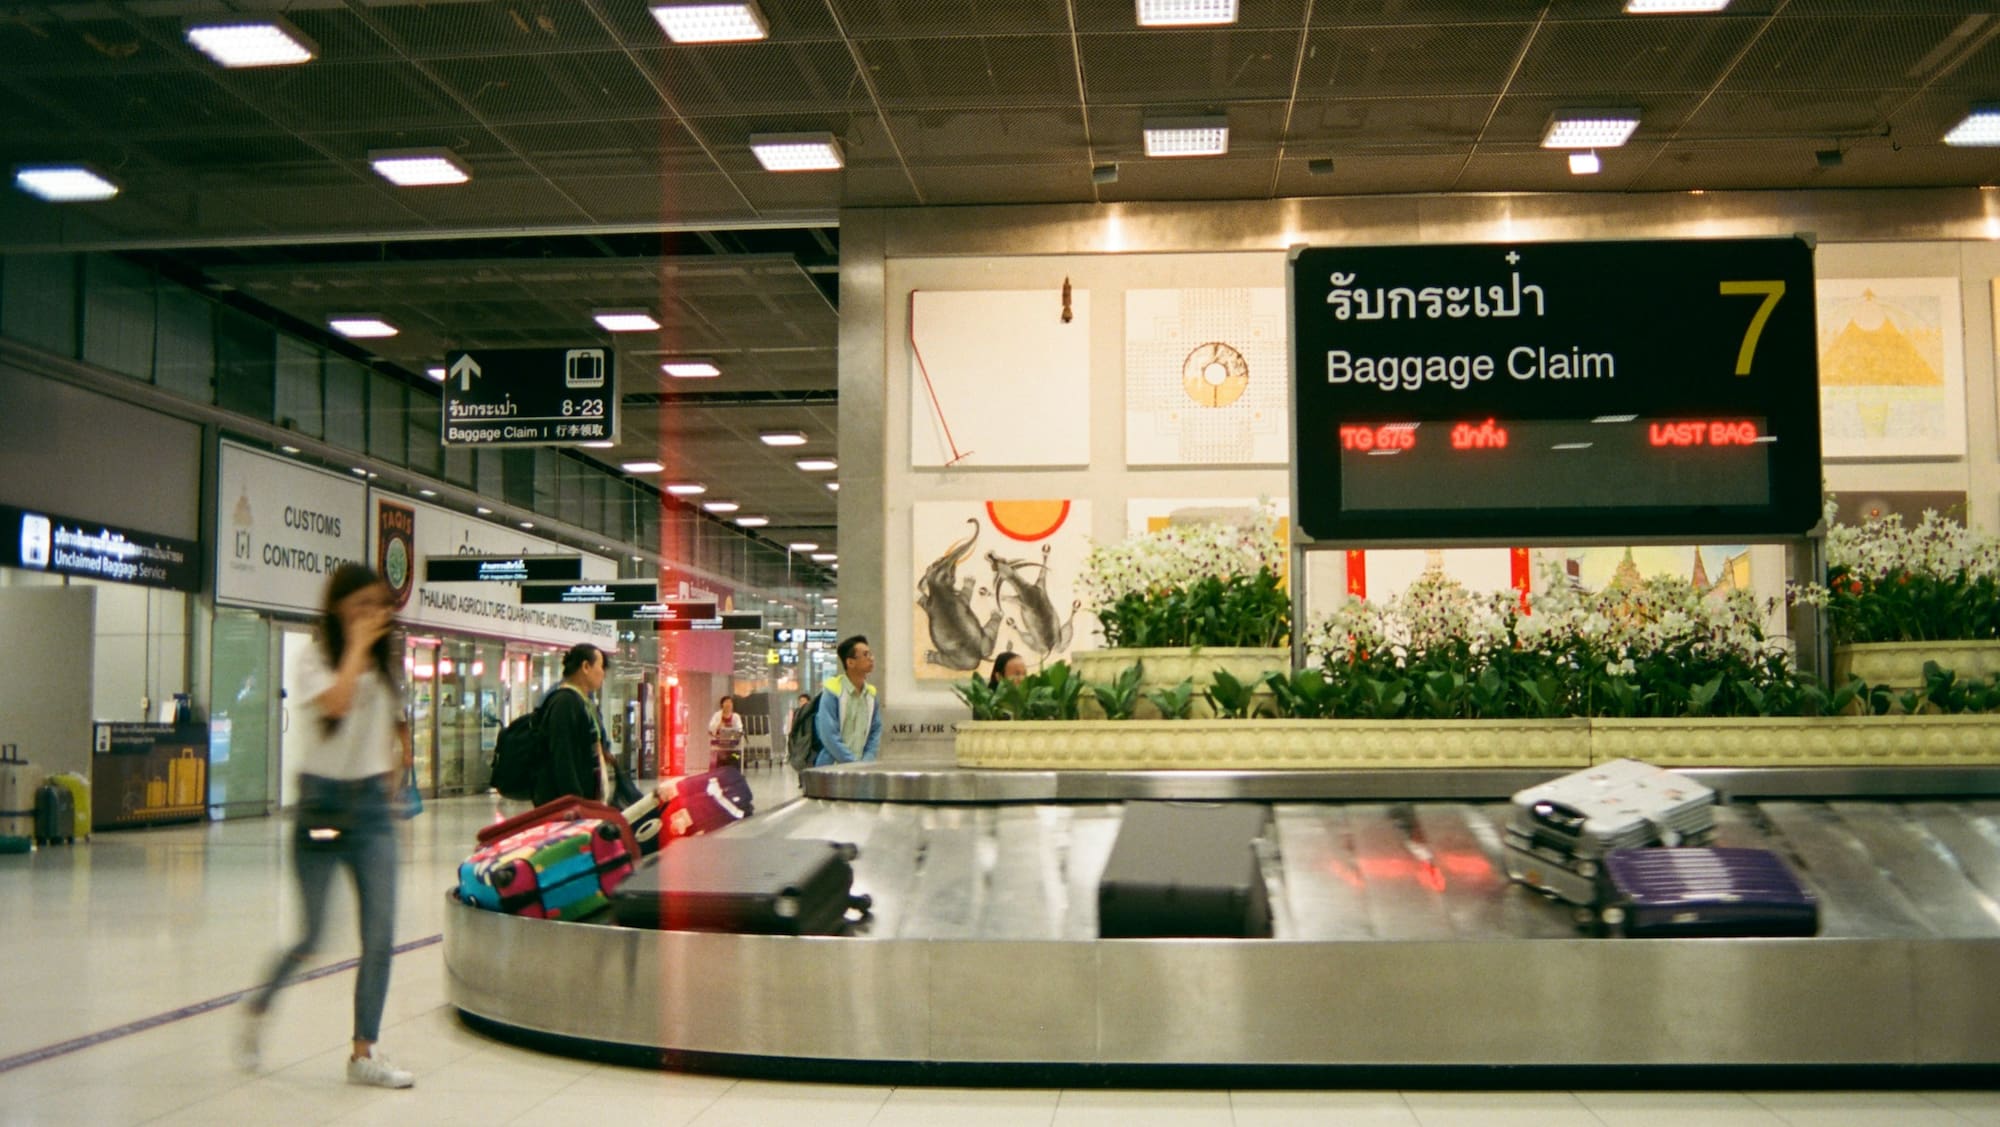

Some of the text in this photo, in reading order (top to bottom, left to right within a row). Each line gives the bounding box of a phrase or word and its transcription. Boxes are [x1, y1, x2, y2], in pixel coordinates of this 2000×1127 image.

[1327, 251, 1545, 320] รับกระเป๋า
[1719, 281, 1785, 376] 7
[1327, 346, 1615, 391] Baggage Claim
[449, 426, 538, 442] Baggage Claim
[1341, 426, 1416, 450] TG 675
[1649, 420, 1757, 446] LAST BAG
[284, 505, 342, 538] CUSTOMS
[55, 549, 167, 580] Unclaimed Baggage Service
[263, 543, 322, 575] CONTROL
[419, 588, 457, 611] THAILAND
[458, 595, 506, 620] AGRICULTURE
[507, 604, 545, 627] QUARANTINE
[559, 614, 591, 633] INSPECTION
[592, 620, 613, 638] SERVICE
[892, 724, 912, 733] ART
[920, 724, 944, 733] FOR
